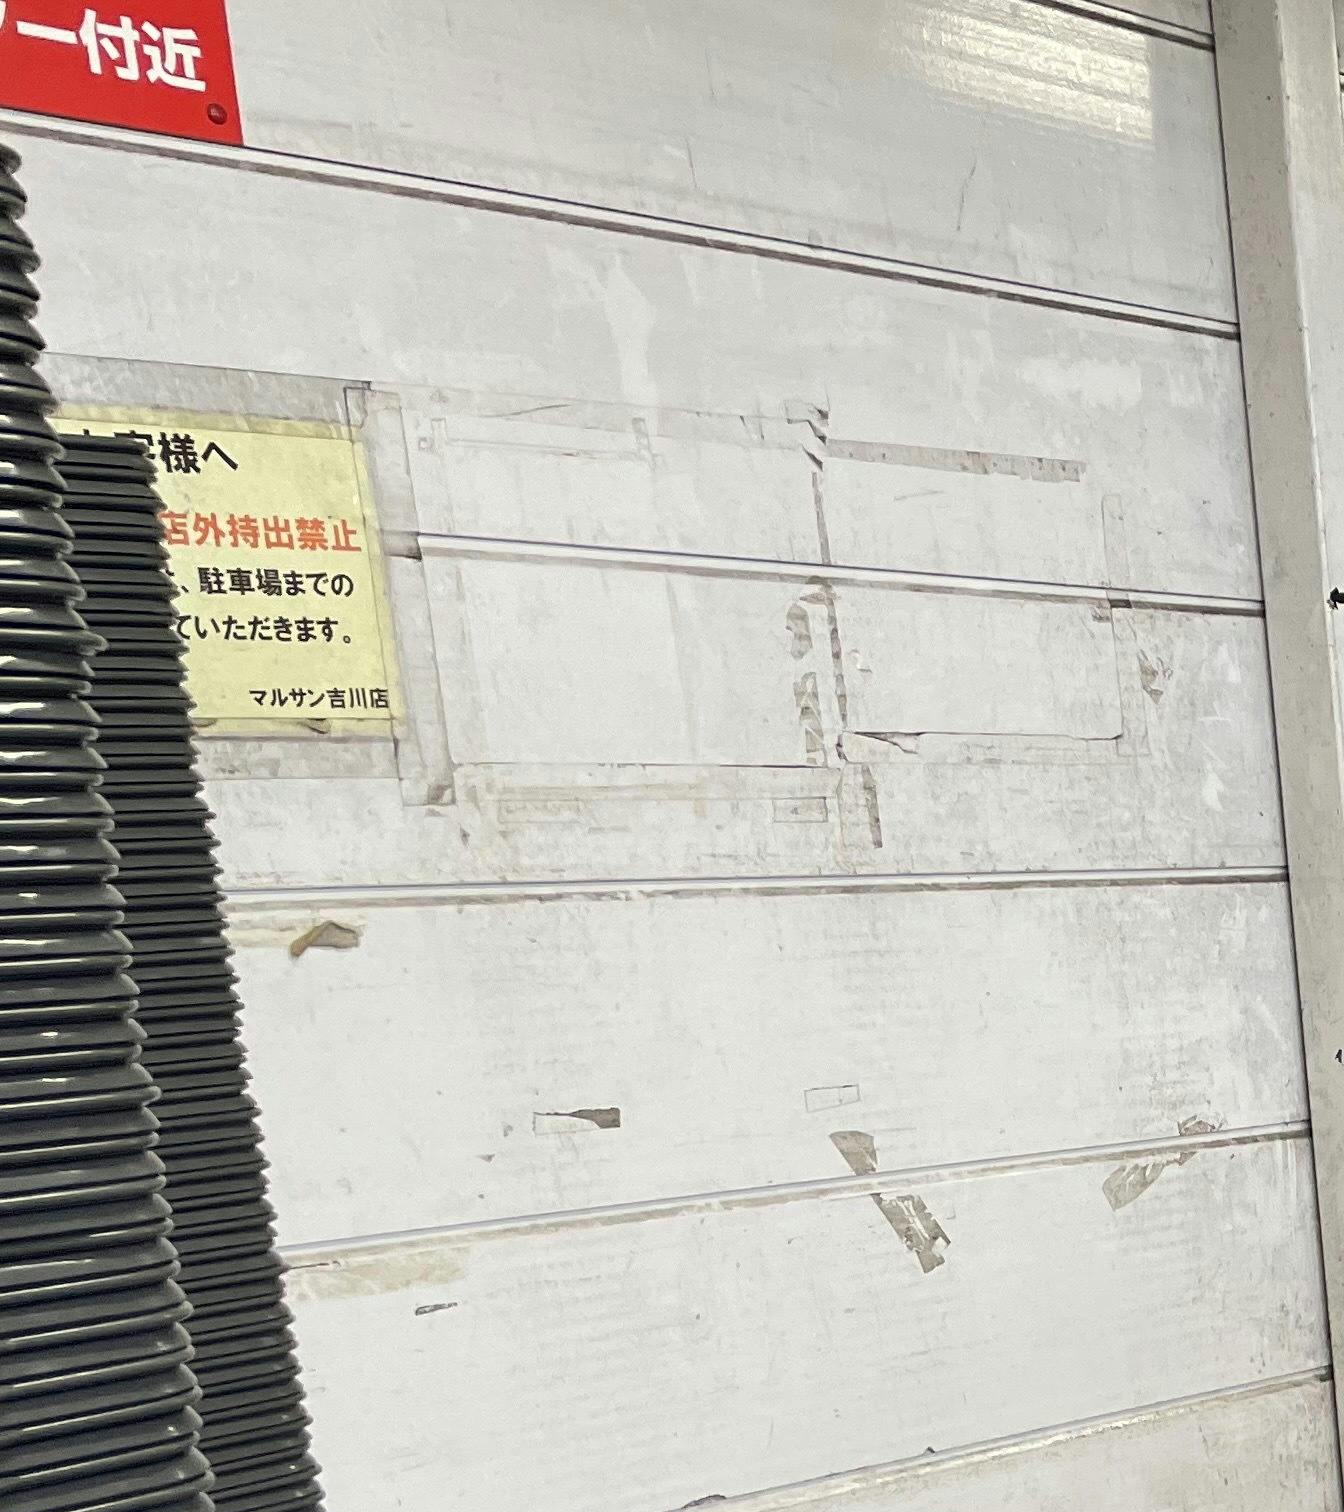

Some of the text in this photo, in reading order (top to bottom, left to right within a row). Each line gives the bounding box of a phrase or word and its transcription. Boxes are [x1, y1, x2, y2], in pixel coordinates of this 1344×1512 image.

[0, 0, 206, 92] ー付近
[167, 567, 354, 597] 、駐車場までの
[249, 687, 389, 709] マルサン吉川店
